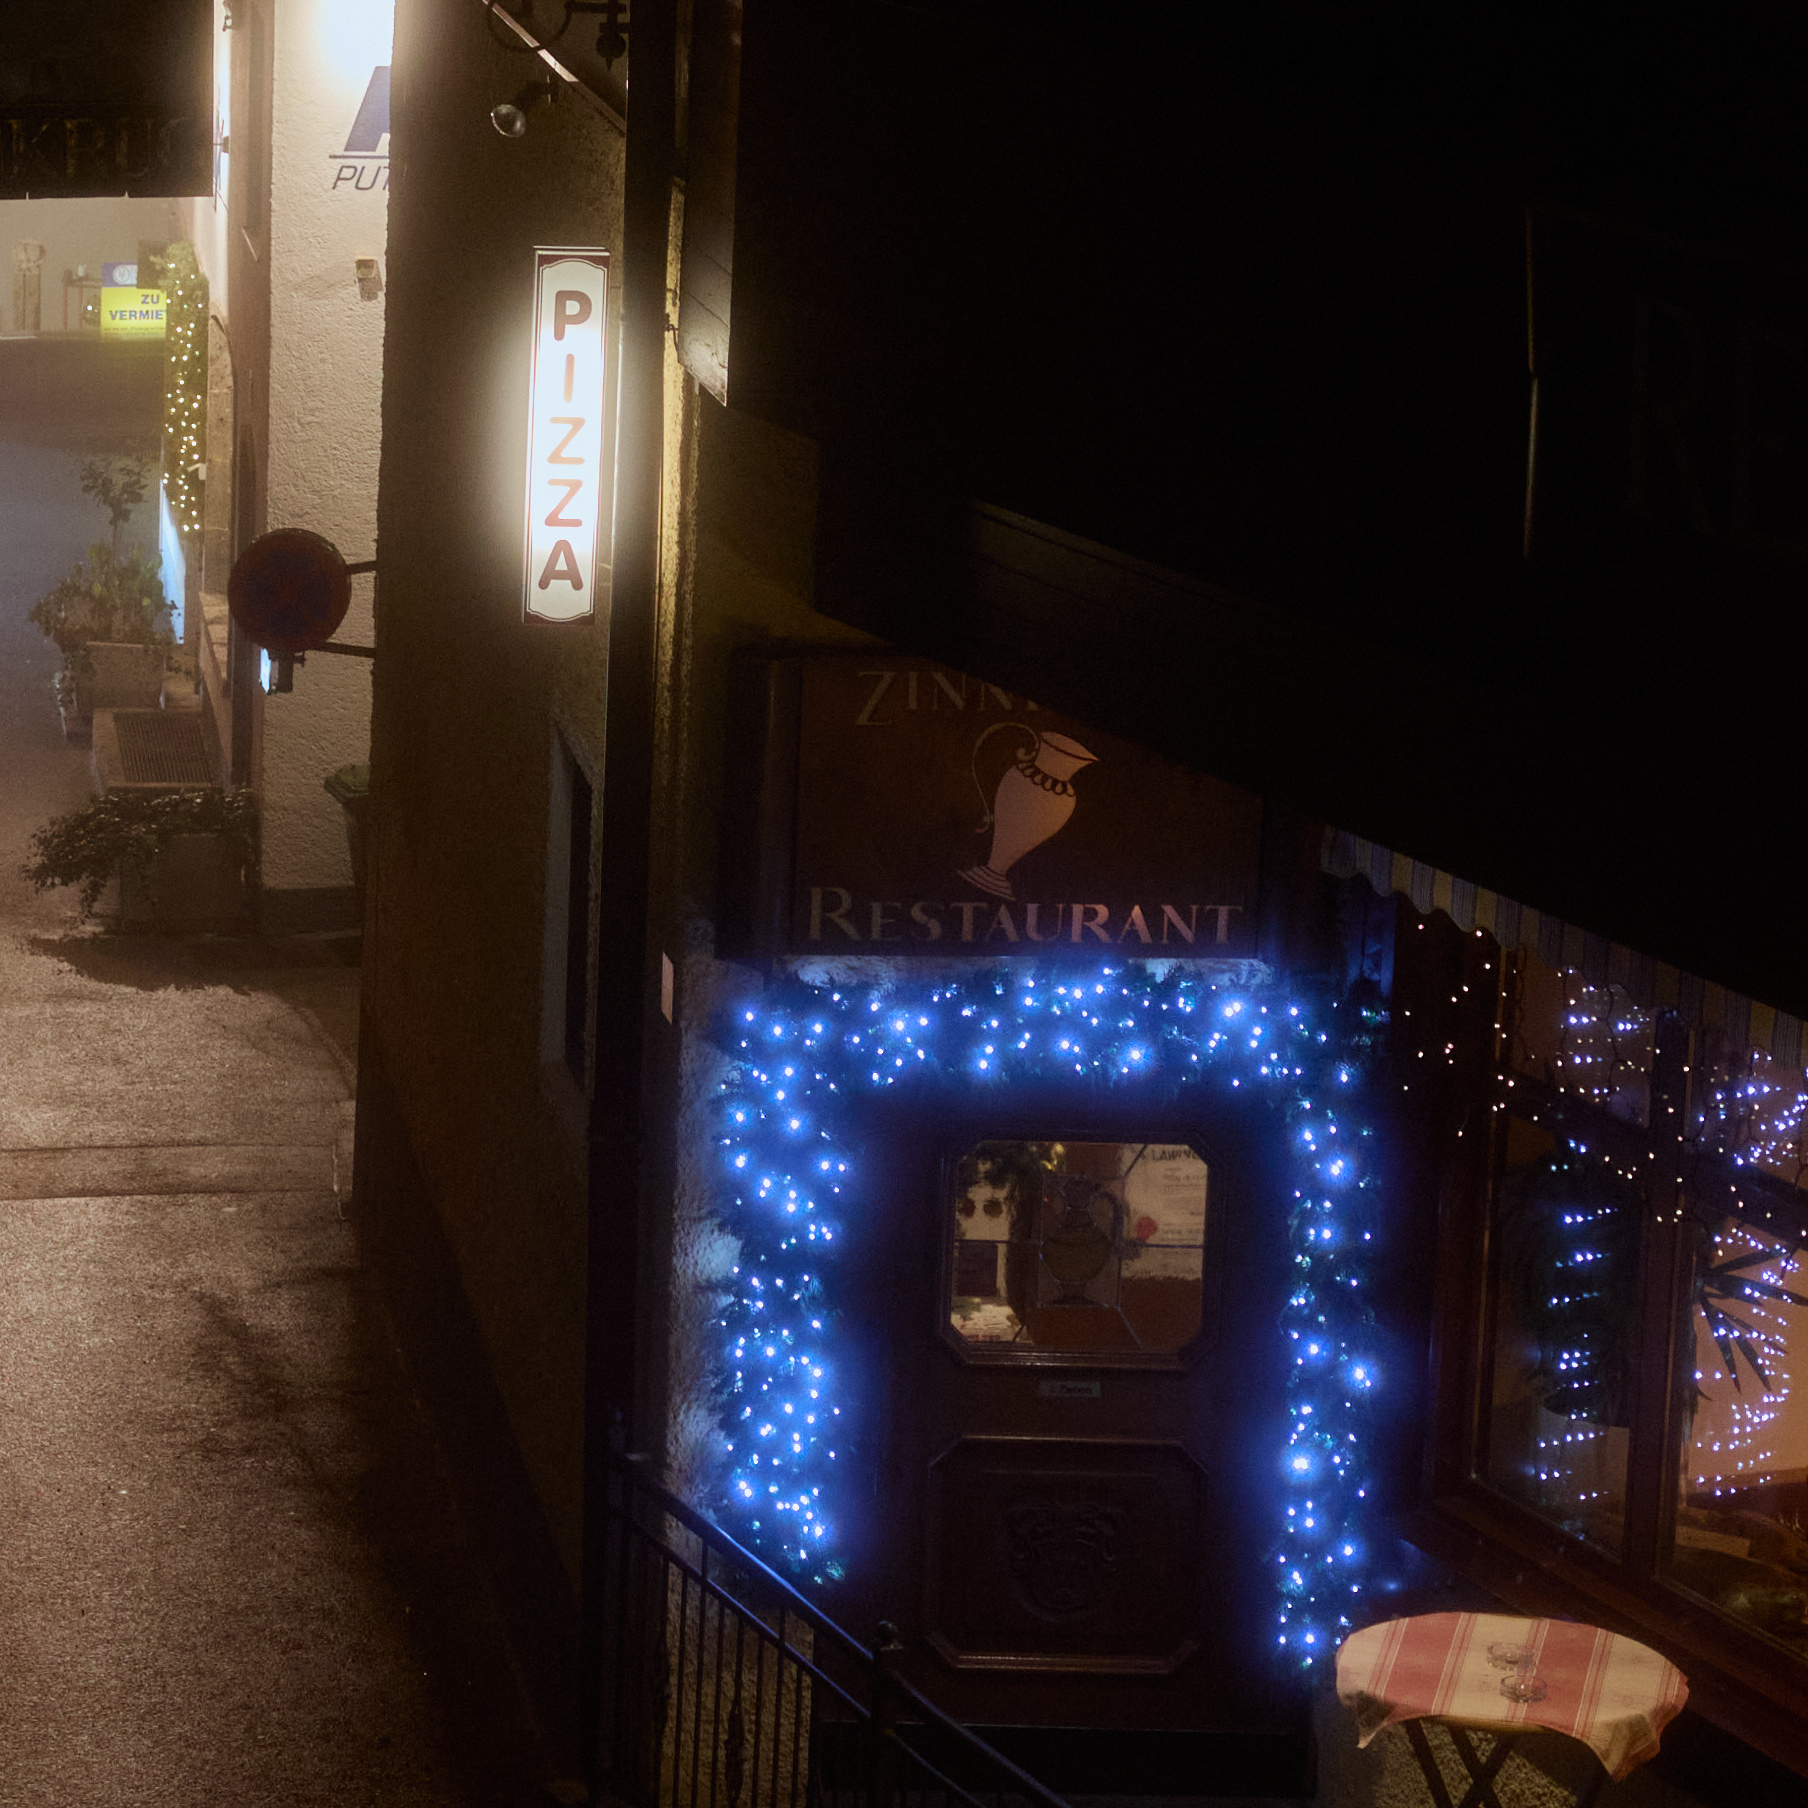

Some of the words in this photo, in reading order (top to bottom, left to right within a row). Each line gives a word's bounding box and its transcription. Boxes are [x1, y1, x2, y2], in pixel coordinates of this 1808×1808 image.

[141, 294, 160, 305] ZU
[539, 290, 592, 591] PIZZA
[856, 671, 1039, 726] ZINN
[808, 887, 1243, 946] RESTAURANT
